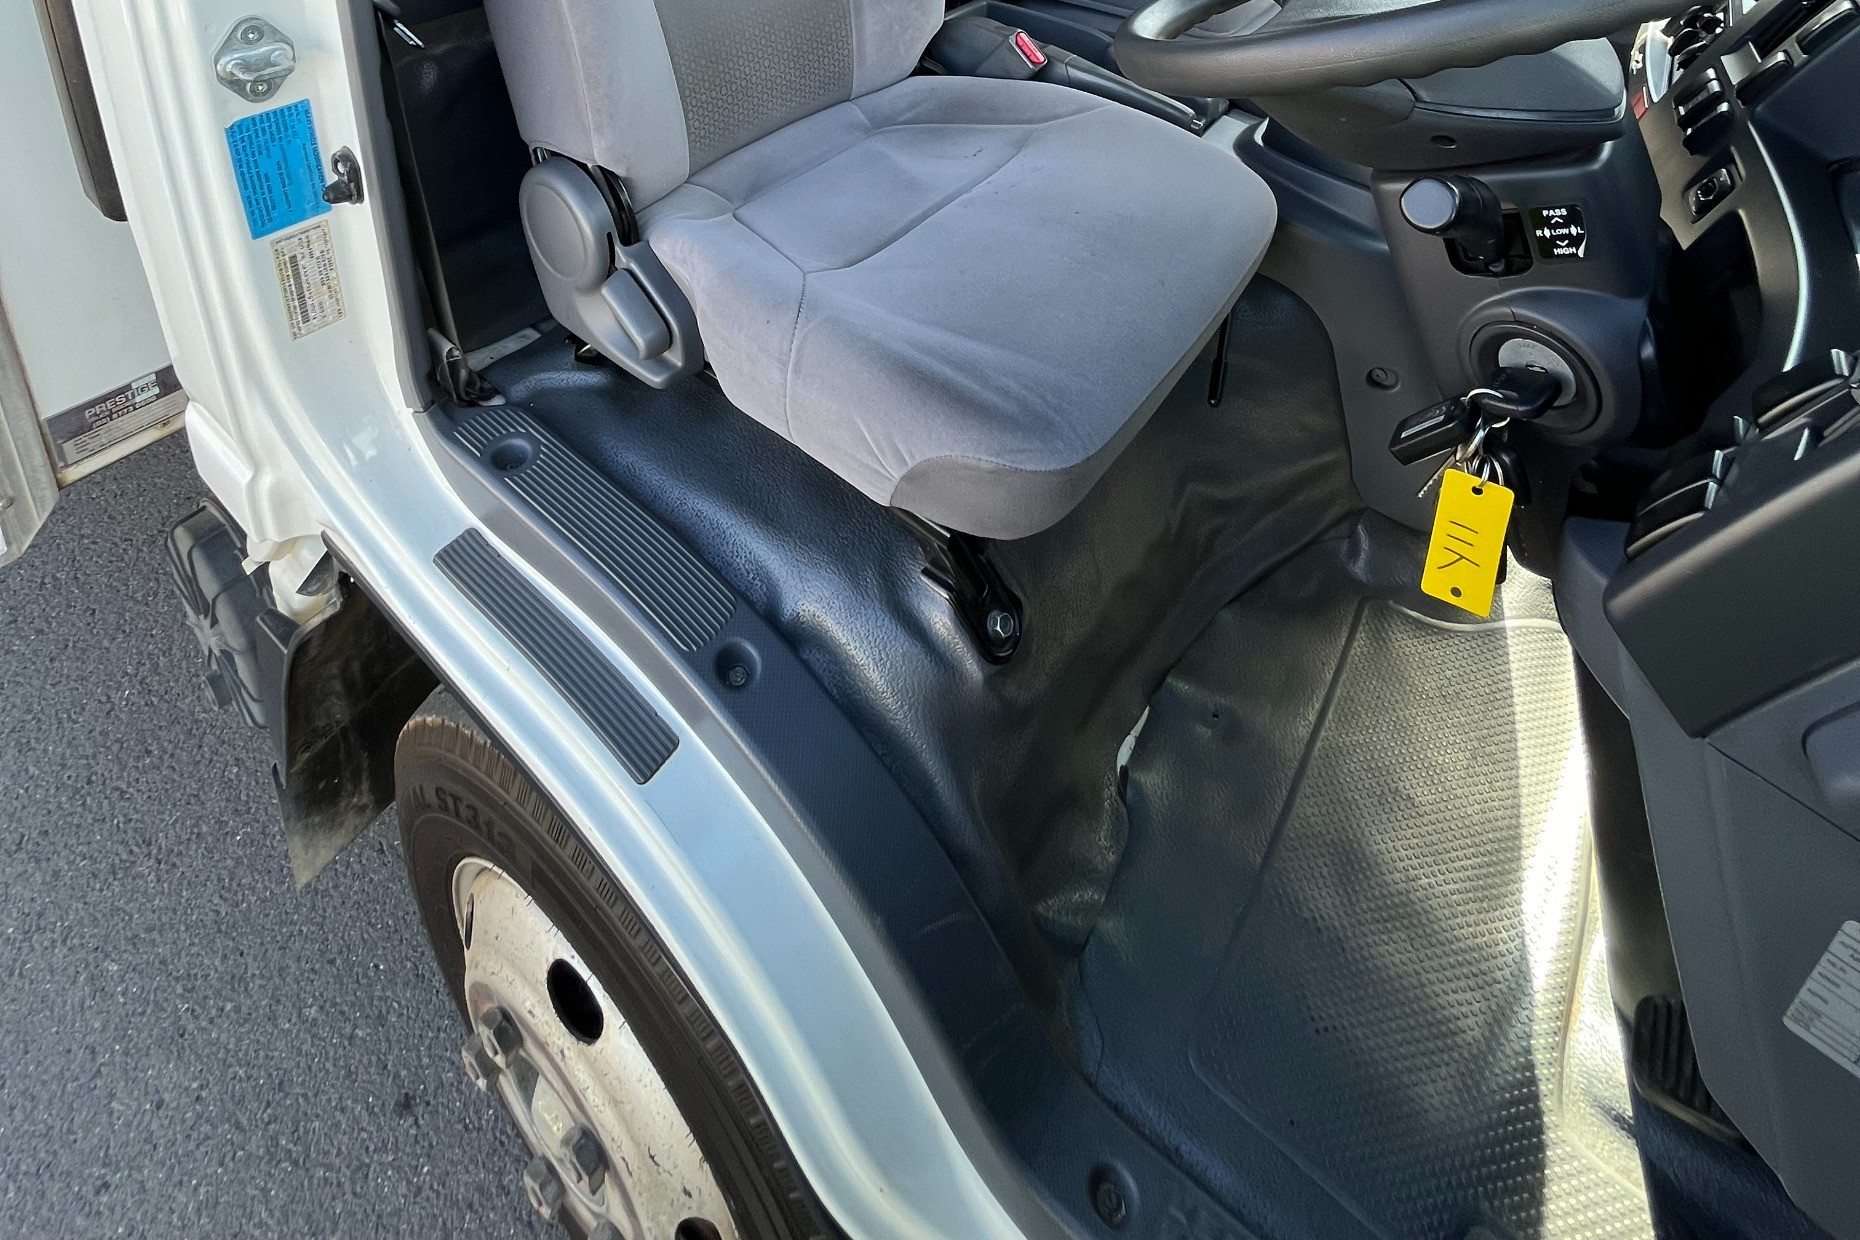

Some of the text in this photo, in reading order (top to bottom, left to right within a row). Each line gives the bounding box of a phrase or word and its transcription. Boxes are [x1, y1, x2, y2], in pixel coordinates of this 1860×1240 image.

[1543, 208, 1568, 217] PASS
[1535, 229, 1544, 237] R
[1577, 226, 1585, 234] L
[1553, 247, 1577, 255] HIGH
[84, 380, 157, 419] PRESTIGE
